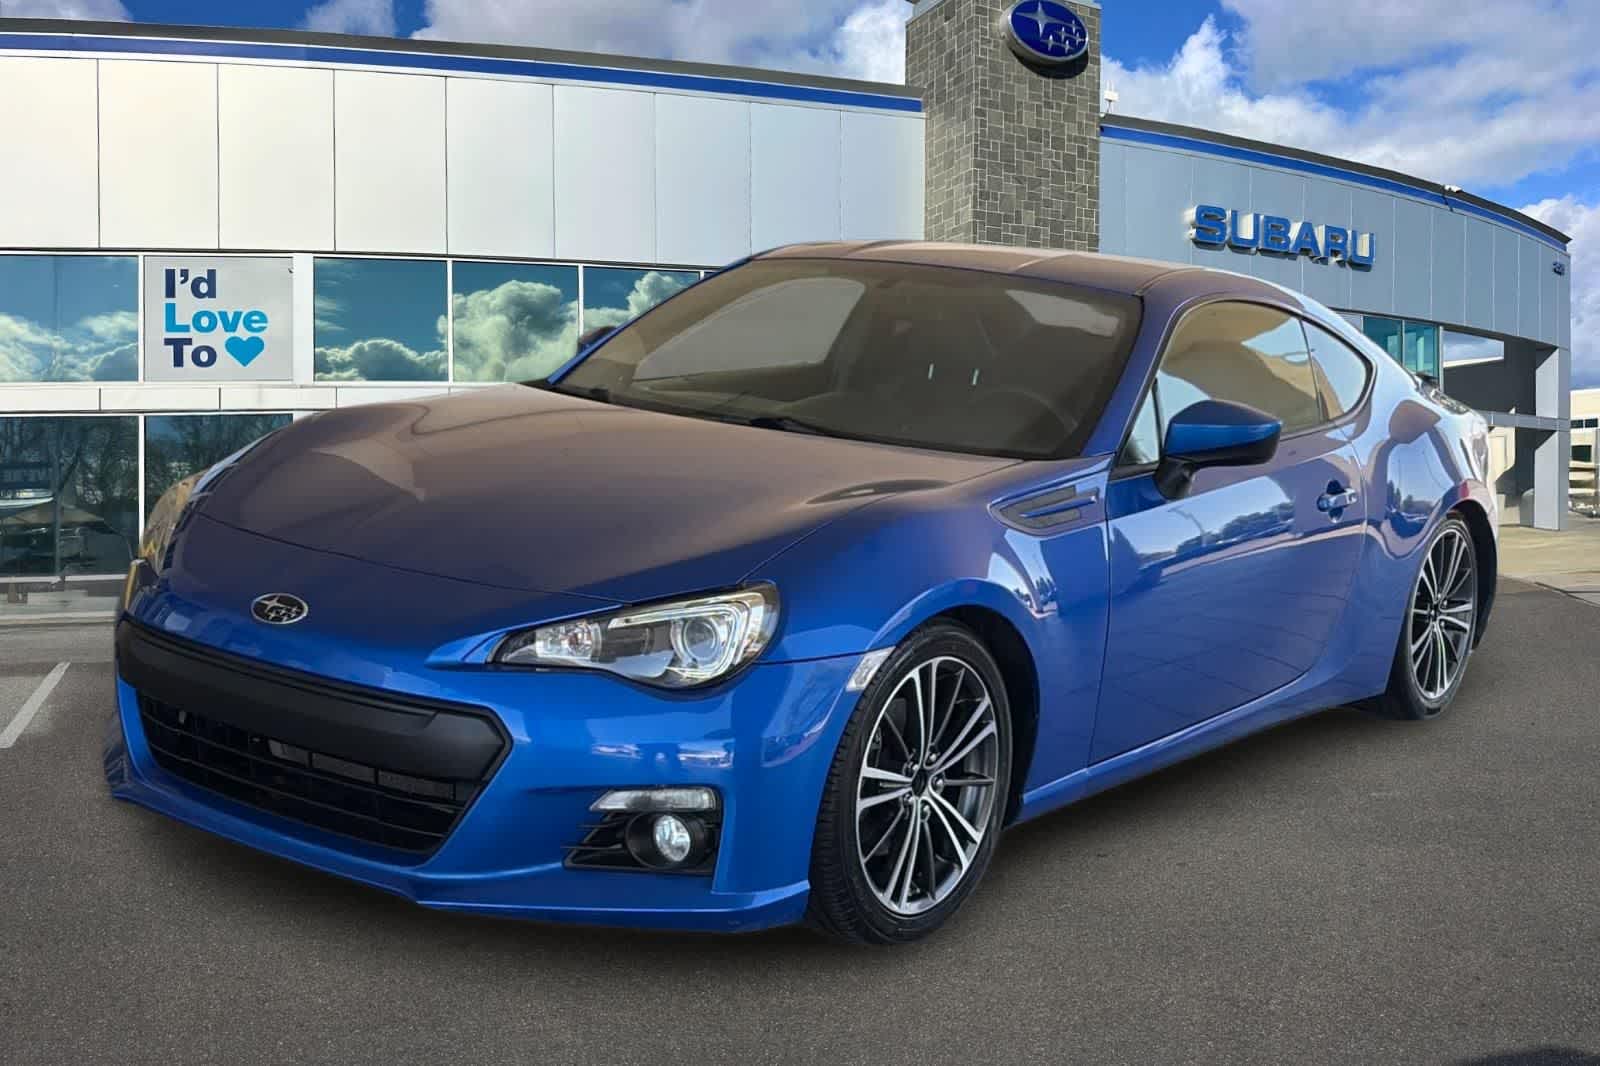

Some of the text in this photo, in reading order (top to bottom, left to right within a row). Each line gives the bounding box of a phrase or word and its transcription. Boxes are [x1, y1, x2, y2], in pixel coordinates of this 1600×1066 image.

[1192, 204, 1376, 269] SUBARU
[165, 268, 217, 299] I'd
[165, 302, 268, 333] Love
[164, 337, 217, 368] To
